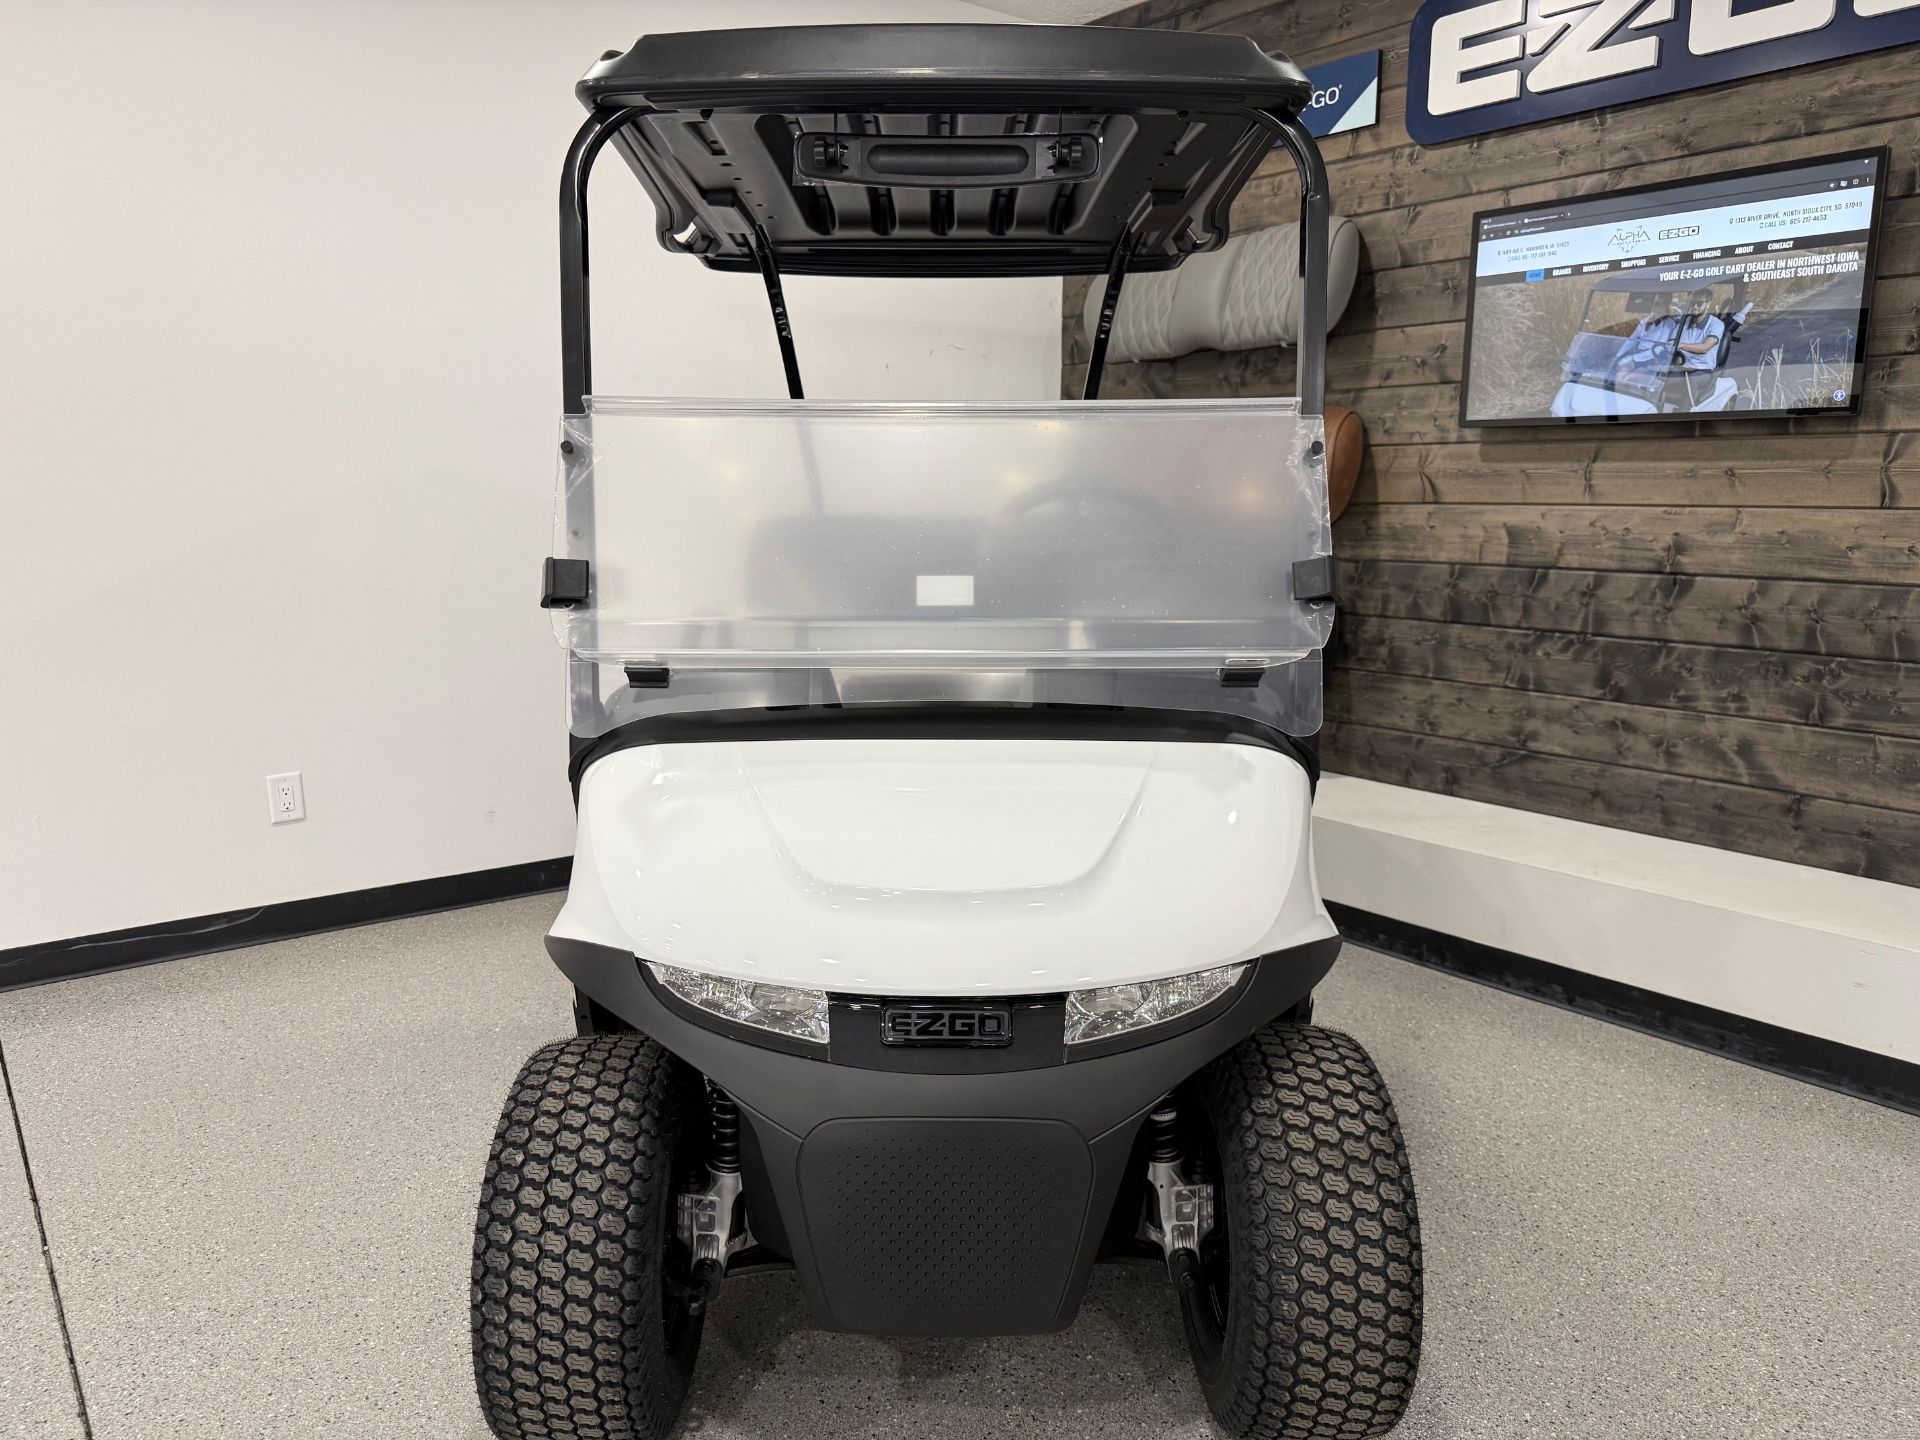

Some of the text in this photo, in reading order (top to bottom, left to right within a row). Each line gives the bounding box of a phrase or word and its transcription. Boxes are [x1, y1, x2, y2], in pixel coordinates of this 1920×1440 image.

[1783, 209, 1800, 218] NORTH
[1608, 229, 1650, 246] ALPHA
[1659, 226, 1700, 240] EZGO
[1552, 267, 1572, 277] BRANDS
[1582, 263, 1609, 273] INVENTORY
[1620, 258, 1647, 268] SHOPPING
[1658, 254, 1680, 264] SERVICE
[1693, 249, 1722, 260] FINANCING
[1734, 245, 1754, 255] ABOUT
[1768, 241, 1794, 250] CONTACT
[1659, 250, 1860, 282] YOUR E-Z-GO GOLF CART DEALER IN NORTHWEST IOWA
[1743, 261, 1858, 282] & SOUTHEAST SOUTH DAKOTA
[890, 1012, 1003, 1037] EZGO
